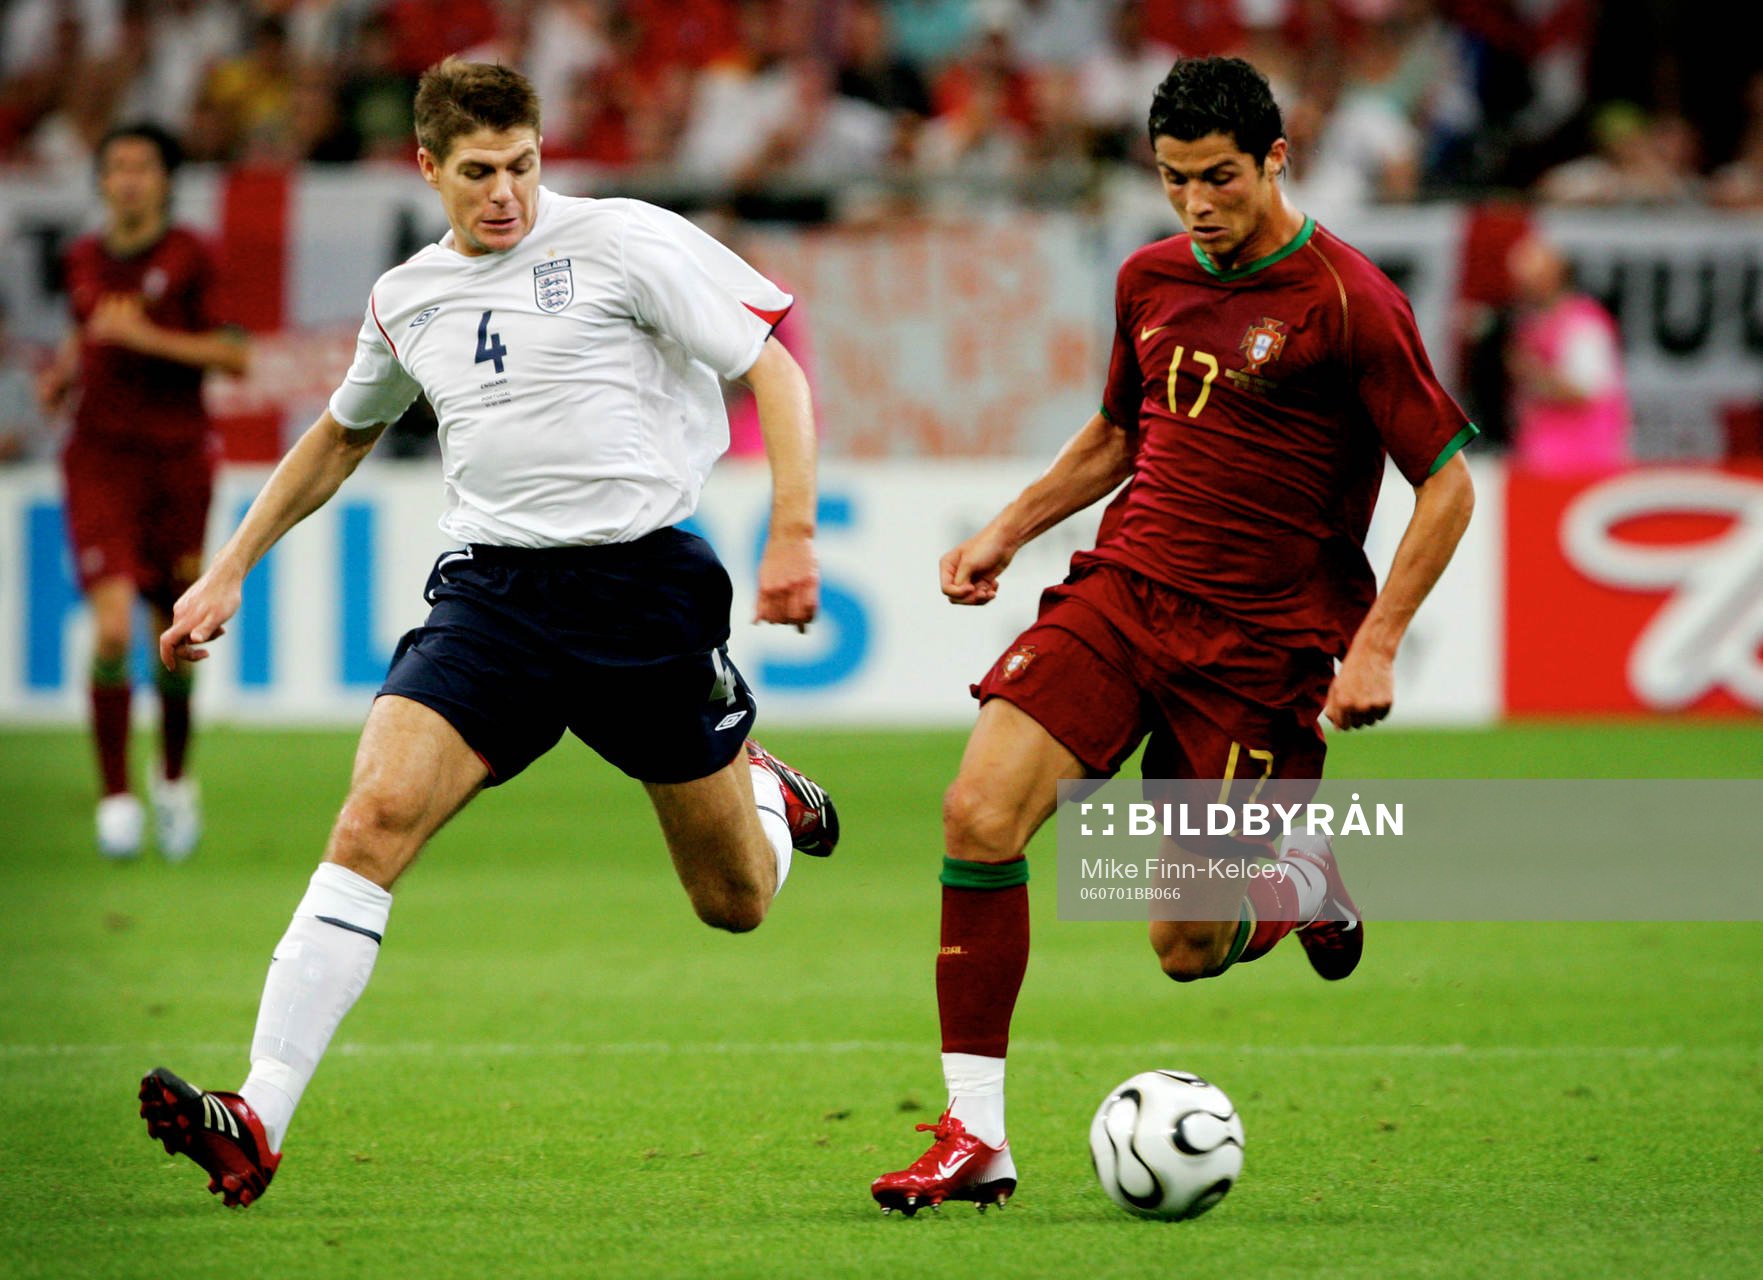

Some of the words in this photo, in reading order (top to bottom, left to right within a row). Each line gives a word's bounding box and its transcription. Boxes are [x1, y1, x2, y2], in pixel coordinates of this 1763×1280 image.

[535, 259, 569, 274] ENGLAND
[475, 309, 507, 374] 4
[1167, 345, 1219, 418] 17
[709, 647, 737, 707] 4
[1216, 741, 1274, 836] 17
